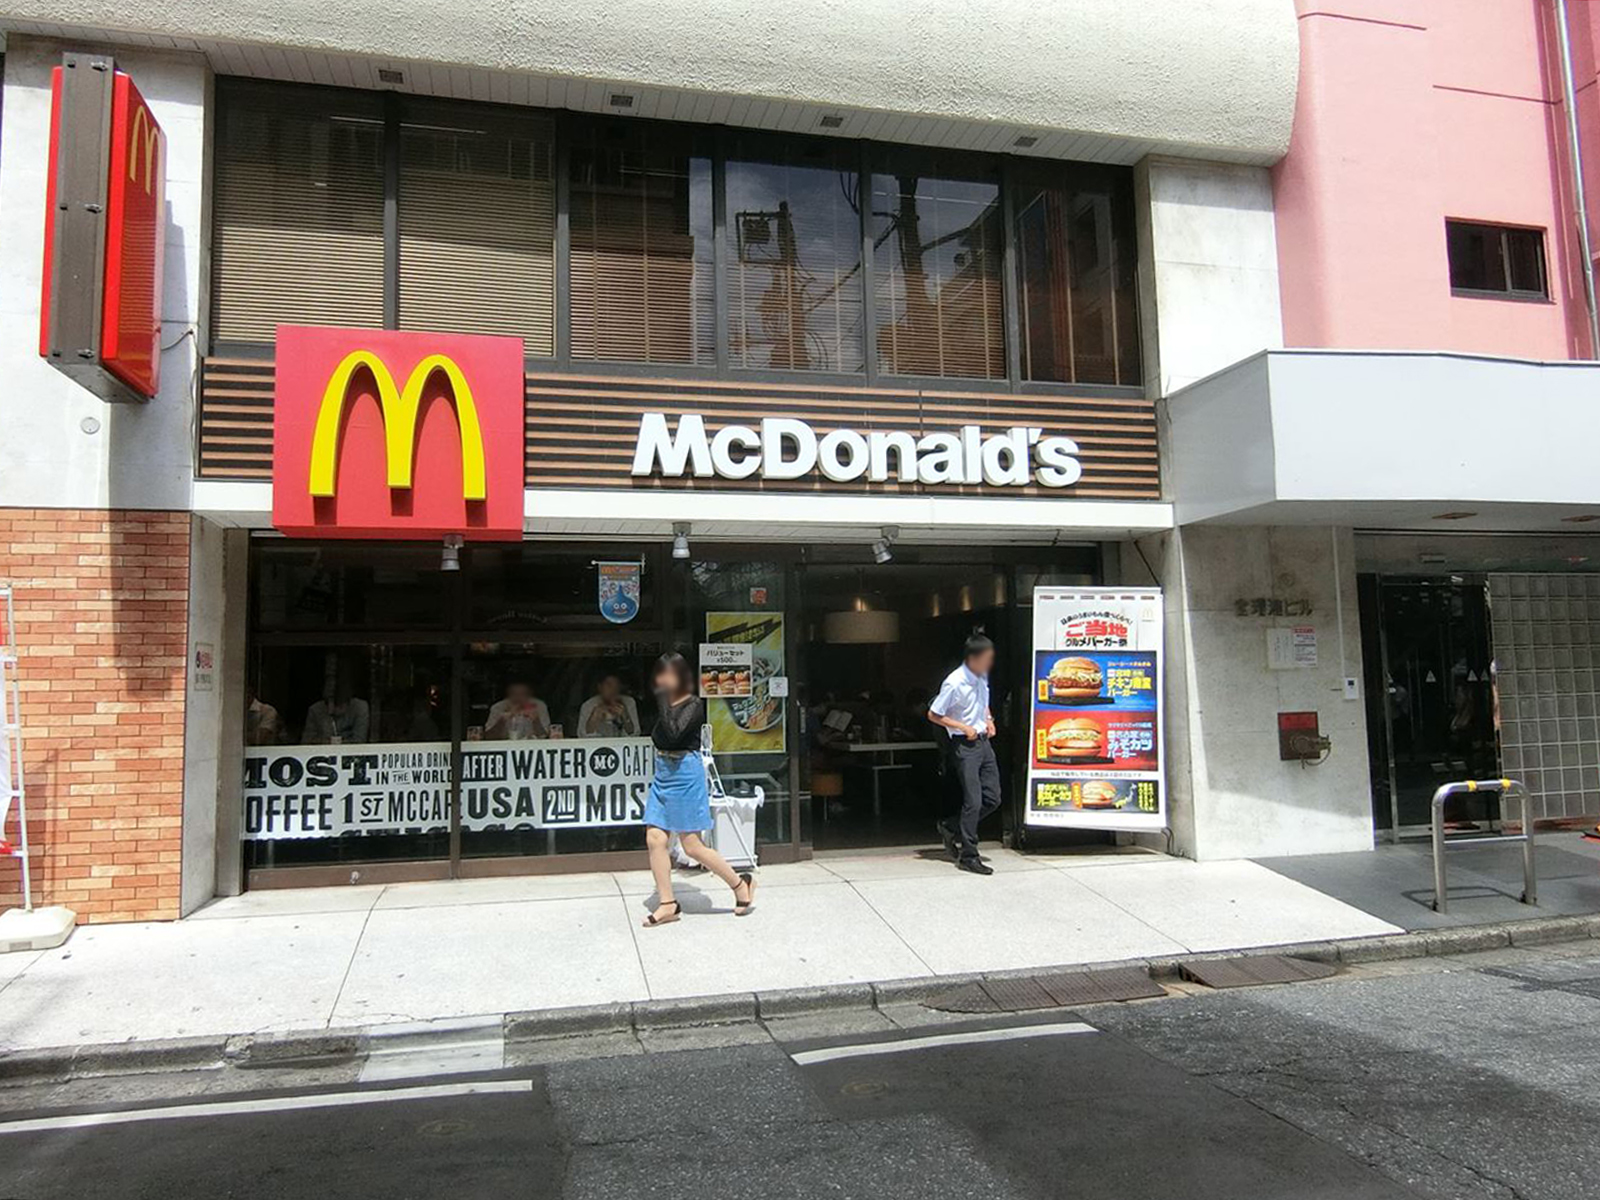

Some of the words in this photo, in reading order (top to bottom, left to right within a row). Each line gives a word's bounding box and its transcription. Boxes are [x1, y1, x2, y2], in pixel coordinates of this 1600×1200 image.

[631, 412, 1082, 488] McDonald's
[1066, 619, 1128, 638] ご当地
[381, 752, 424, 769] POPULAR
[426, 751, 452, 768] DRIN
[463, 754, 505, 780] AFTER
[511, 748, 587, 780] WATER
[592, 754, 616, 771] MC
[376, 770, 389, 785] IN
[392, 771, 410, 783] THE
[388, 788, 463, 822] MCCAF
[467, 786, 535, 820] USA
[546, 788, 576, 821] 2ND
[585, 782, 652, 822] MOS
